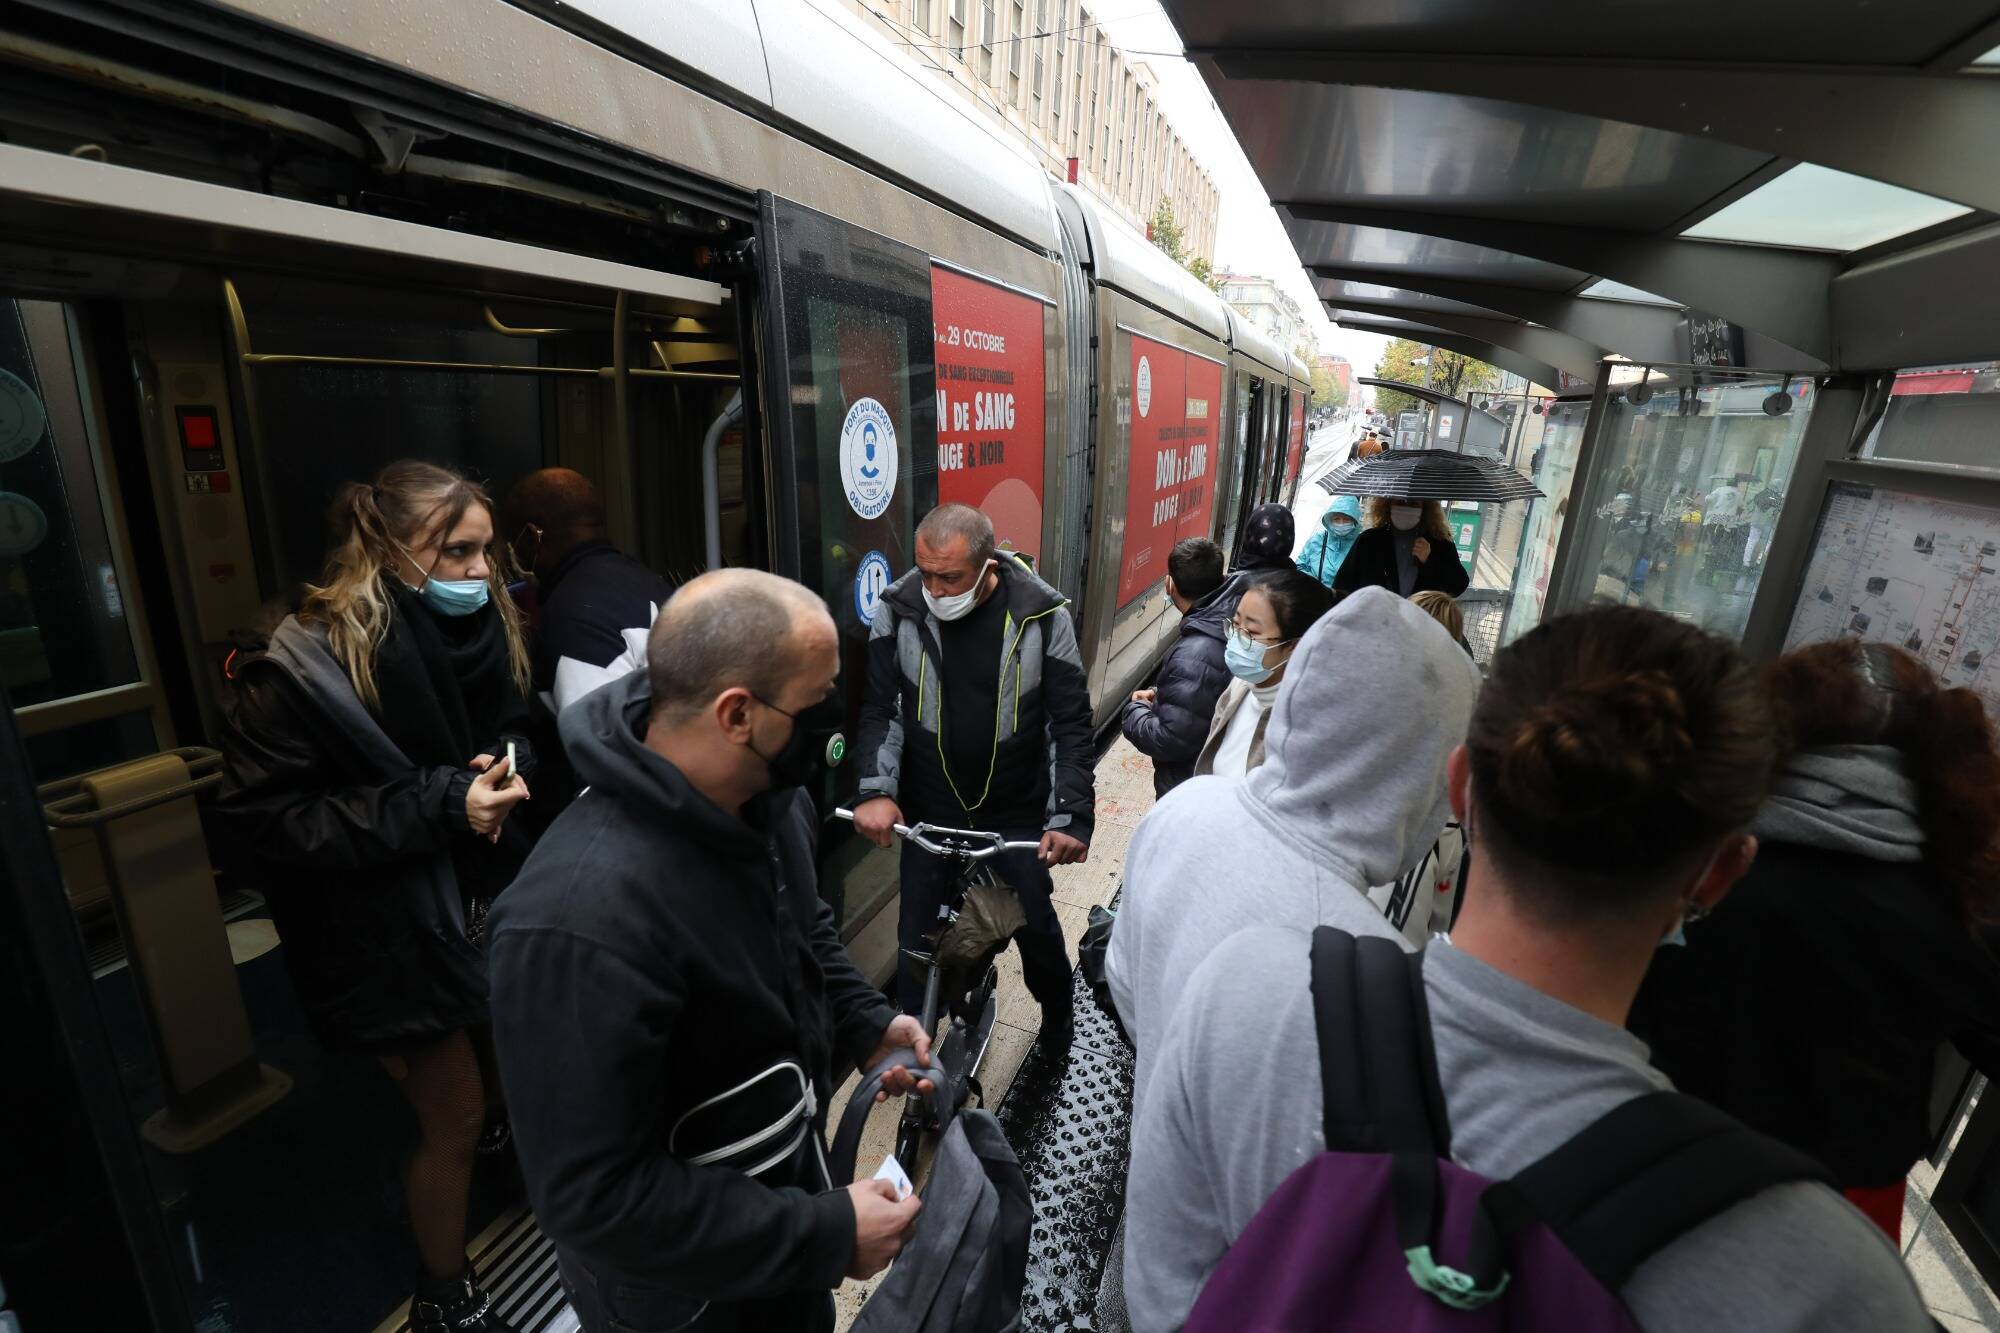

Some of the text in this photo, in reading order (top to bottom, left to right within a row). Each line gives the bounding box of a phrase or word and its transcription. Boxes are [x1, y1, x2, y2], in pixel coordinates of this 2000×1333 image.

[947, 325, 960, 346] 29
[963, 328, 1005, 353] OCTOBRE
[843, 401, 894, 439] PORT DU MASQUE
[953, 402, 970, 431] DE
[974, 391, 1015, 431] SANG
[938, 441, 1004, 471] UGE & NOIR
[1155, 443, 1207, 491] DON DE SANG
[848, 489, 891, 517] OBLIGATOIRE
[1152, 494, 1179, 528] ROUGE
